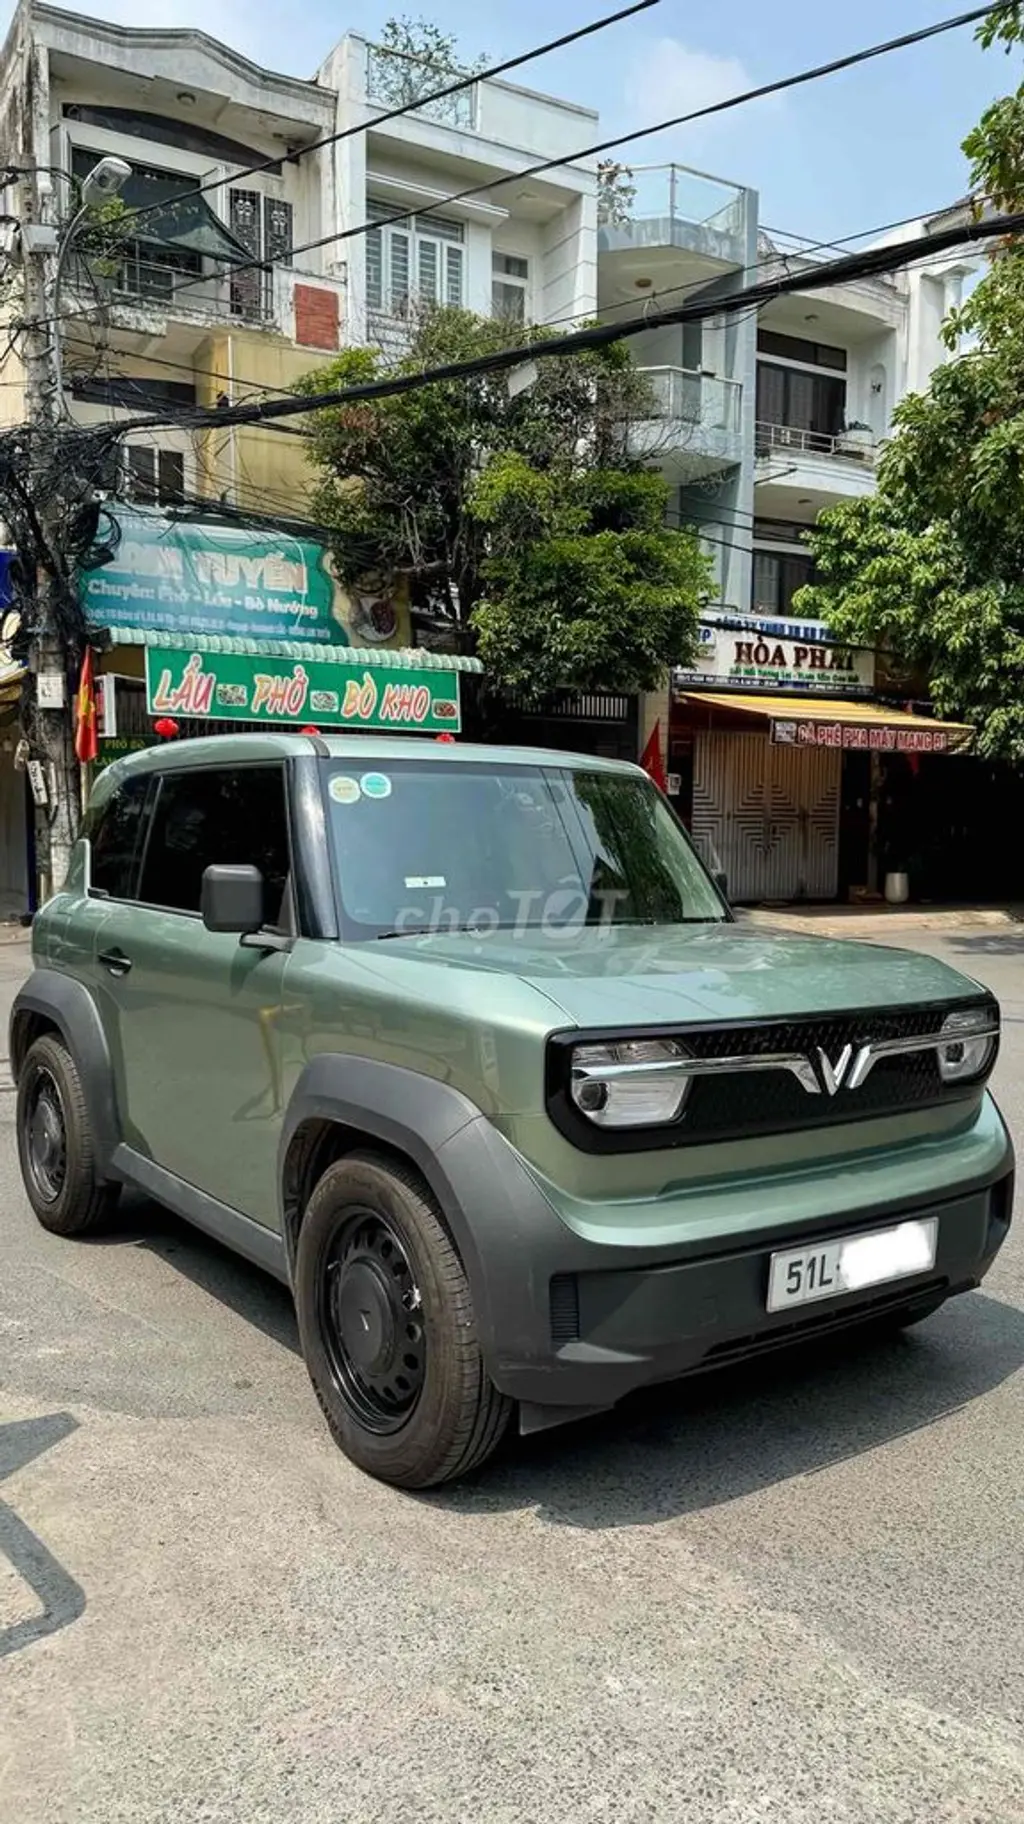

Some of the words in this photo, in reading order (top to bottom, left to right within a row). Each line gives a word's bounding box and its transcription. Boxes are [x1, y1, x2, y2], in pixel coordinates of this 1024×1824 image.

[734, 636, 787, 666] HÒA
[153, 654, 216, 714] LẨU
[252, 665, 308, 716] PHỞ
[341, 671, 378, 720] BÒ
[379, 683, 430, 722] KHO
